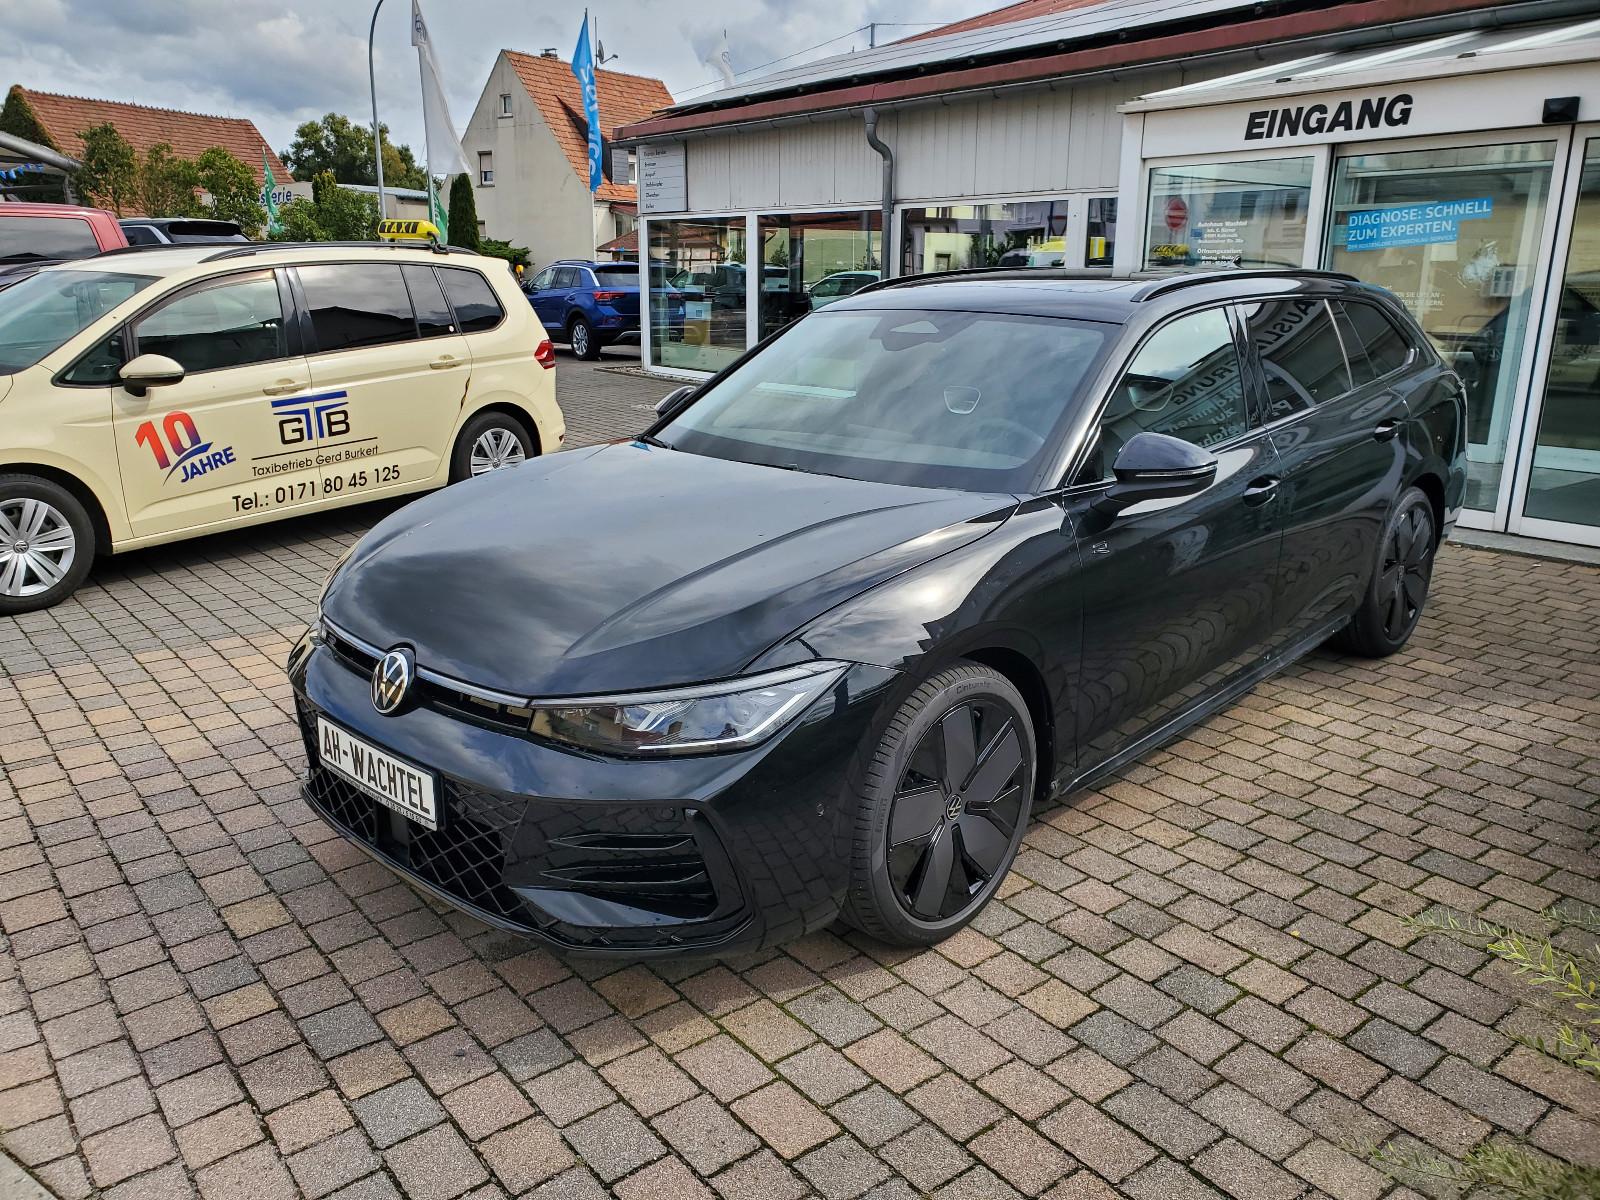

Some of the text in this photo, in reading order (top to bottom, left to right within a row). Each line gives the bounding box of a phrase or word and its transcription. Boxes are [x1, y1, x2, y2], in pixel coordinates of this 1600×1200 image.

[1244, 93, 1413, 141] EINGANG
[384, 221, 413, 233] TAXI
[1348, 220, 1456, 241] ZUM EXPERTEN.
[1349, 199, 1491, 227] DIAGNOSE: SCHNELL
[134, 410, 201, 470] 10
[180, 446, 237, 483] JAHRE
[252, 445, 378, 477] Taxibetrieb Gerd Burkert
[232, 465, 400, 512] Tel.: 0171 80 45 125
[323, 725, 431, 815] AH-WACHTEL
